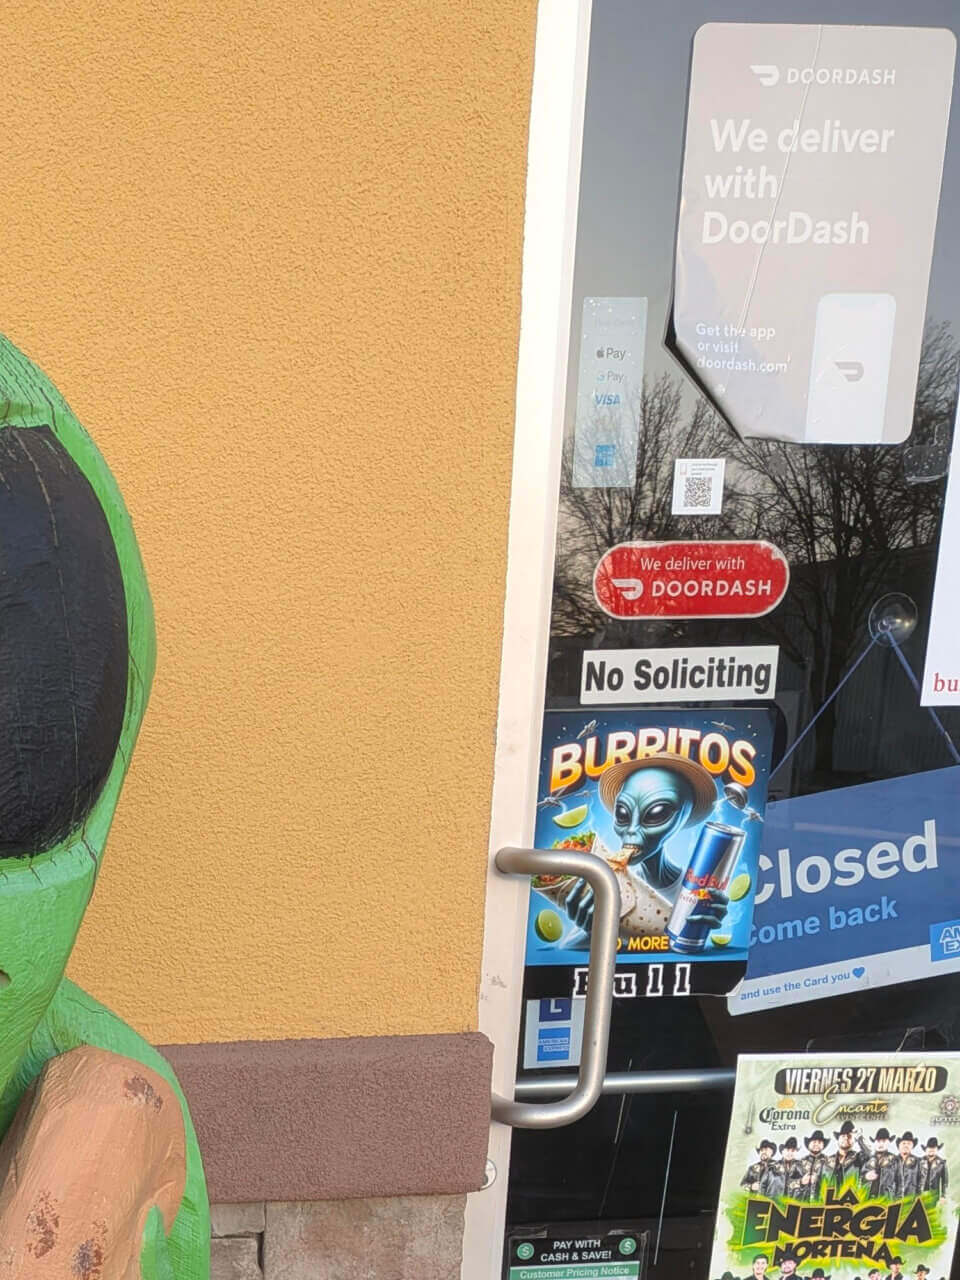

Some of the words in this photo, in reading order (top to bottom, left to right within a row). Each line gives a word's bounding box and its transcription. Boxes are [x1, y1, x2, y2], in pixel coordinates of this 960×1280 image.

[787, 68, 896, 85] DOORDASH
[710, 119, 769, 152] We
[777, 120, 895, 152] deliver
[704, 166, 778, 198] with
[702, 211, 870, 245] DoorDash
[695, 323, 720, 337] Get
[723, 324, 746, 337] the
[749, 327, 776, 341] app
[606, 347, 626, 360] Pay
[697, 343, 710, 352] or
[712, 342, 739, 353] visit
[696, 357, 788, 373] doordash.com
[607, 371, 625, 383] Pay
[595, 394, 621, 405] VISA
[640, 557, 662, 570] We
[665, 557, 711, 570] deliver
[715, 557, 745, 570] with
[652, 580, 772, 597] DOORDASH
[585, 661, 624, 692] No
[633, 656, 772, 694] Soliciting
[550, 727, 757, 793] BURRITOS
[828, 896, 898, 931] back
[628, 936, 669, 950] MORE
[740, 987, 760, 1000] and
[762, 985, 782, 996] use
[784, 980, 801, 993] the
[803, 976, 828, 989] Card
[830, 971, 850, 984] you
[785, 1068, 852, 1094] VIERNES
[854, 1068, 876, 1093] 27
[877, 1067, 936, 1092] MARZO
[812, 1084, 888, 1126] Encanto
[759, 1107, 810, 1123] Corona
[770, 1121, 796, 1131] Extra
[824, 1187, 861, 1206] LA
[553, 1241, 573, 1250] PAY
[574, 1240, 601, 1249] WITH
[774, 1236, 895, 1270] NORTEÑA
[541, 1253, 569, 1263] CASH
[572, 1252, 579, 1261] &
[582, 1251, 612, 1260] SAVE!
[520, 1270, 564, 1279] Customer
[568, 1268, 599, 1278] Pricing
[601, 1266, 629, 1275] Notice
